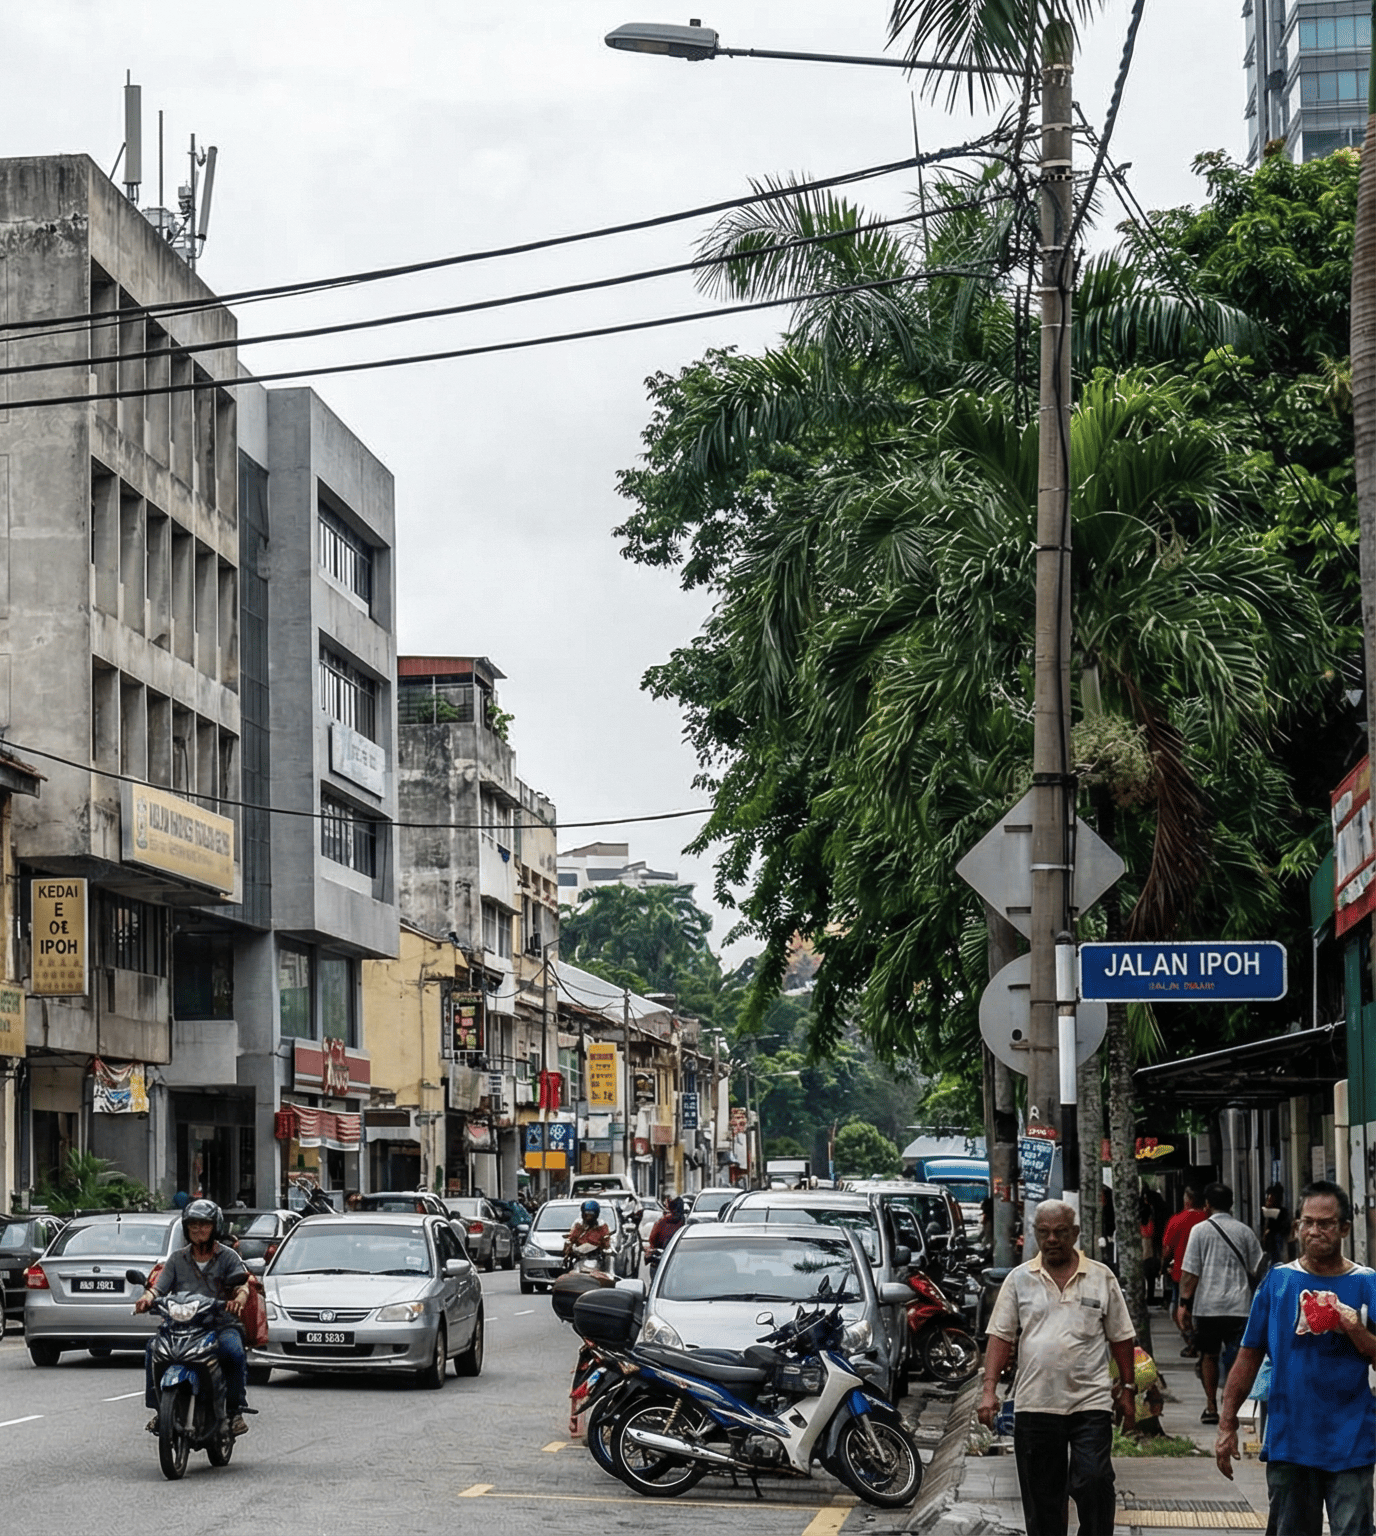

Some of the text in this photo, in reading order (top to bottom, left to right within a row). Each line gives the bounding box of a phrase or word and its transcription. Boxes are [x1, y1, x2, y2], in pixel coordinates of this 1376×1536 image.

[38, 885, 78, 899] KEDAI
[54, 902, 64, 917] E
[40, 939, 78, 955] IPOH
[1104, 952, 1260, 976] JALAN IPOH
